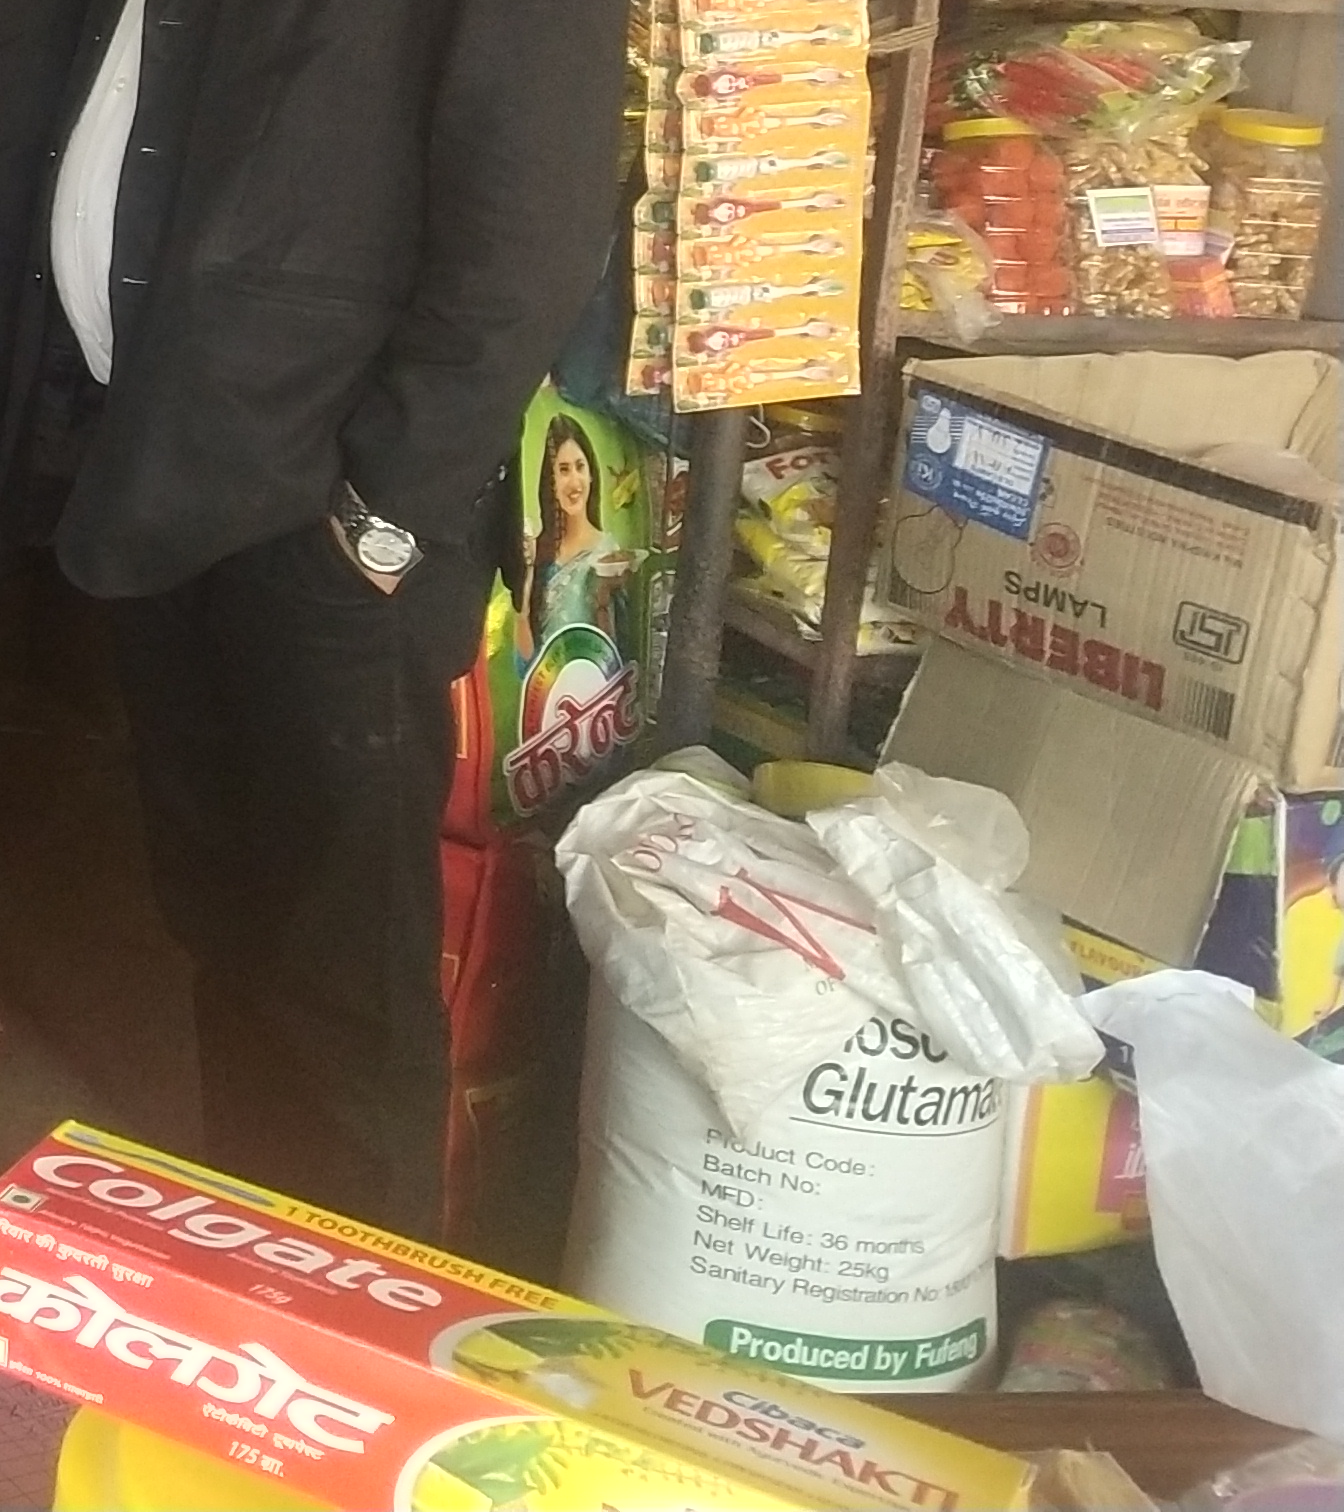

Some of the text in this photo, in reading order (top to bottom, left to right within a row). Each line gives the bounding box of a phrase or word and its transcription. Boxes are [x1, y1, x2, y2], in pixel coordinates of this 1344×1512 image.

[1004, 569, 1108, 629] LAMPS
[943, 585, 1168, 712] LIBERTY
[703, 1153, 821, 1196] Batch No:
[806, 1151, 875, 1177] Code:
[701, 1179, 763, 1210] MFD:
[31, 1154, 443, 1313] Colgate
[696, 1204, 925, 1255] Shelf Life: 36 months
[35, 1233, 58, 1252] की
[56, 1242, 110, 1272] कुदरती
[111, 1262, 155, 1289] सुरक्षा
[303, 1210, 486, 1286] TOOTHBRUSH
[488, 1276, 559, 1311] FREE
[690, 1255, 786, 1295] Sanitary
[792, 1278, 909, 1303] Registration
[693, 1230, 889, 1284] Net Weight: 25kg
[728, 1327, 978, 1374] Produced by Fufeng
[35, 1371, 62, 1388] 100%
[627, 1367, 960, 1512] VEDSHAKTI
[721, 1389, 867, 1450] Cibaca
[227, 1440, 258, 1465] 175
